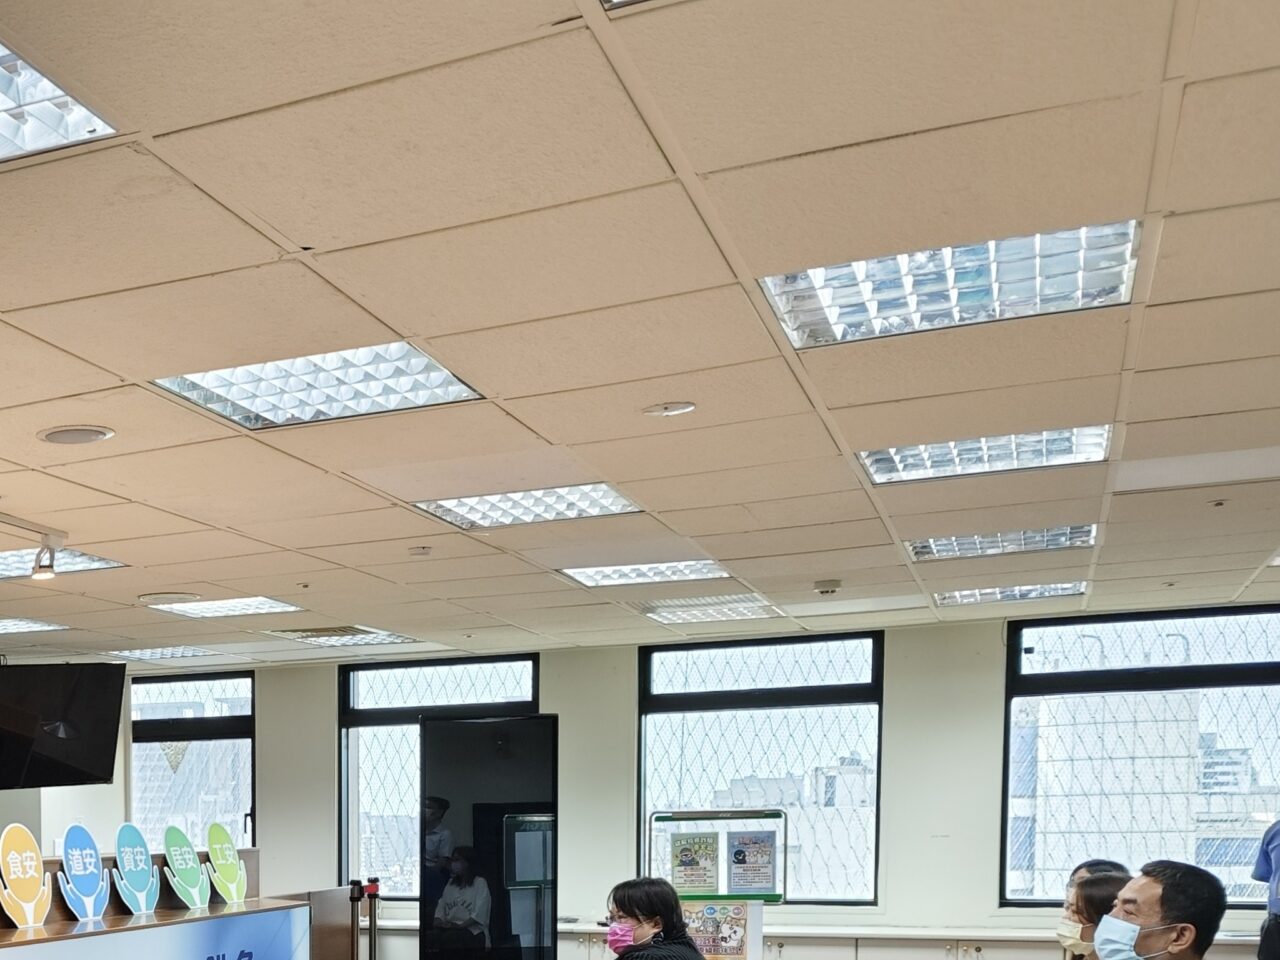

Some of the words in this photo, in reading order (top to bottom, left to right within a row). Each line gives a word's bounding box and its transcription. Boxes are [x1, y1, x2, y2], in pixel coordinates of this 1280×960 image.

[6, 851, 39, 880] 食安
[68, 848, 97, 876] 道安
[120, 846, 148, 872] 資安
[169, 846, 197, 869] 居安
[213, 843, 237, 865] 工安
